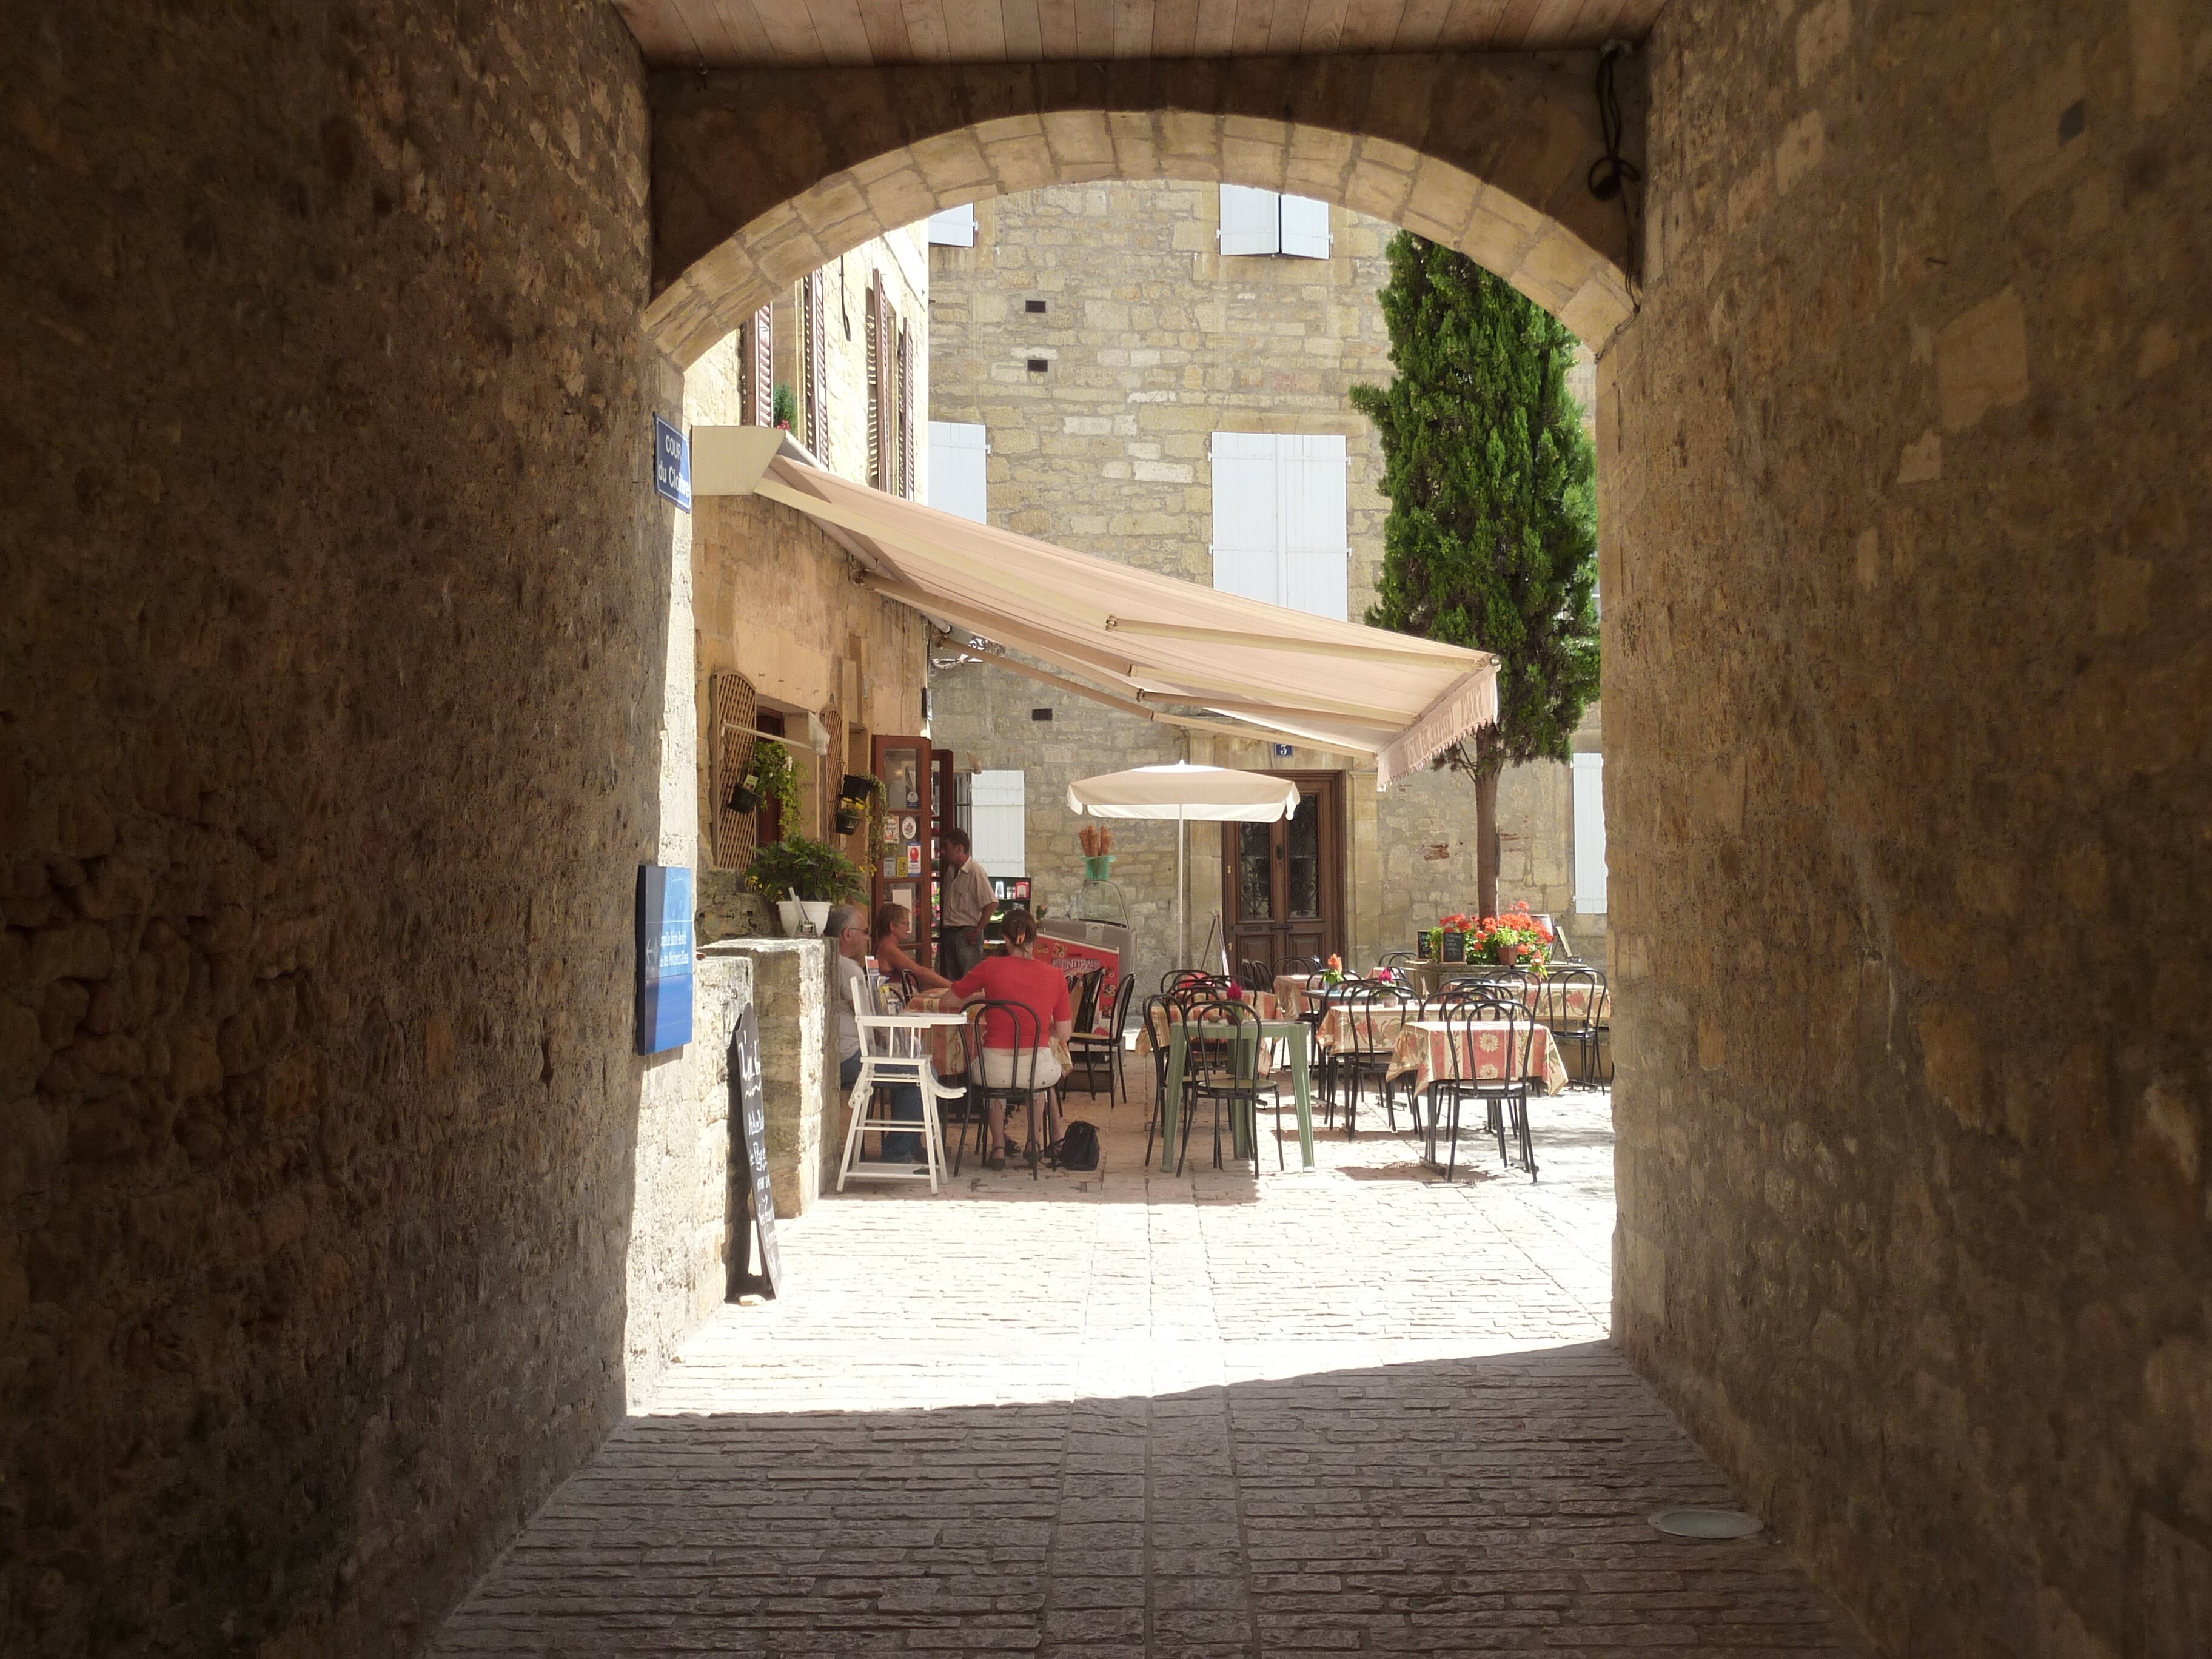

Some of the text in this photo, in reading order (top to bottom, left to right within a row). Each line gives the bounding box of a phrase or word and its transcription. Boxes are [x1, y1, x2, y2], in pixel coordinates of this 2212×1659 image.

[665, 434, 682, 461] COUR
[658, 459, 667, 483] du
[1280, 744, 1287, 756] 3
